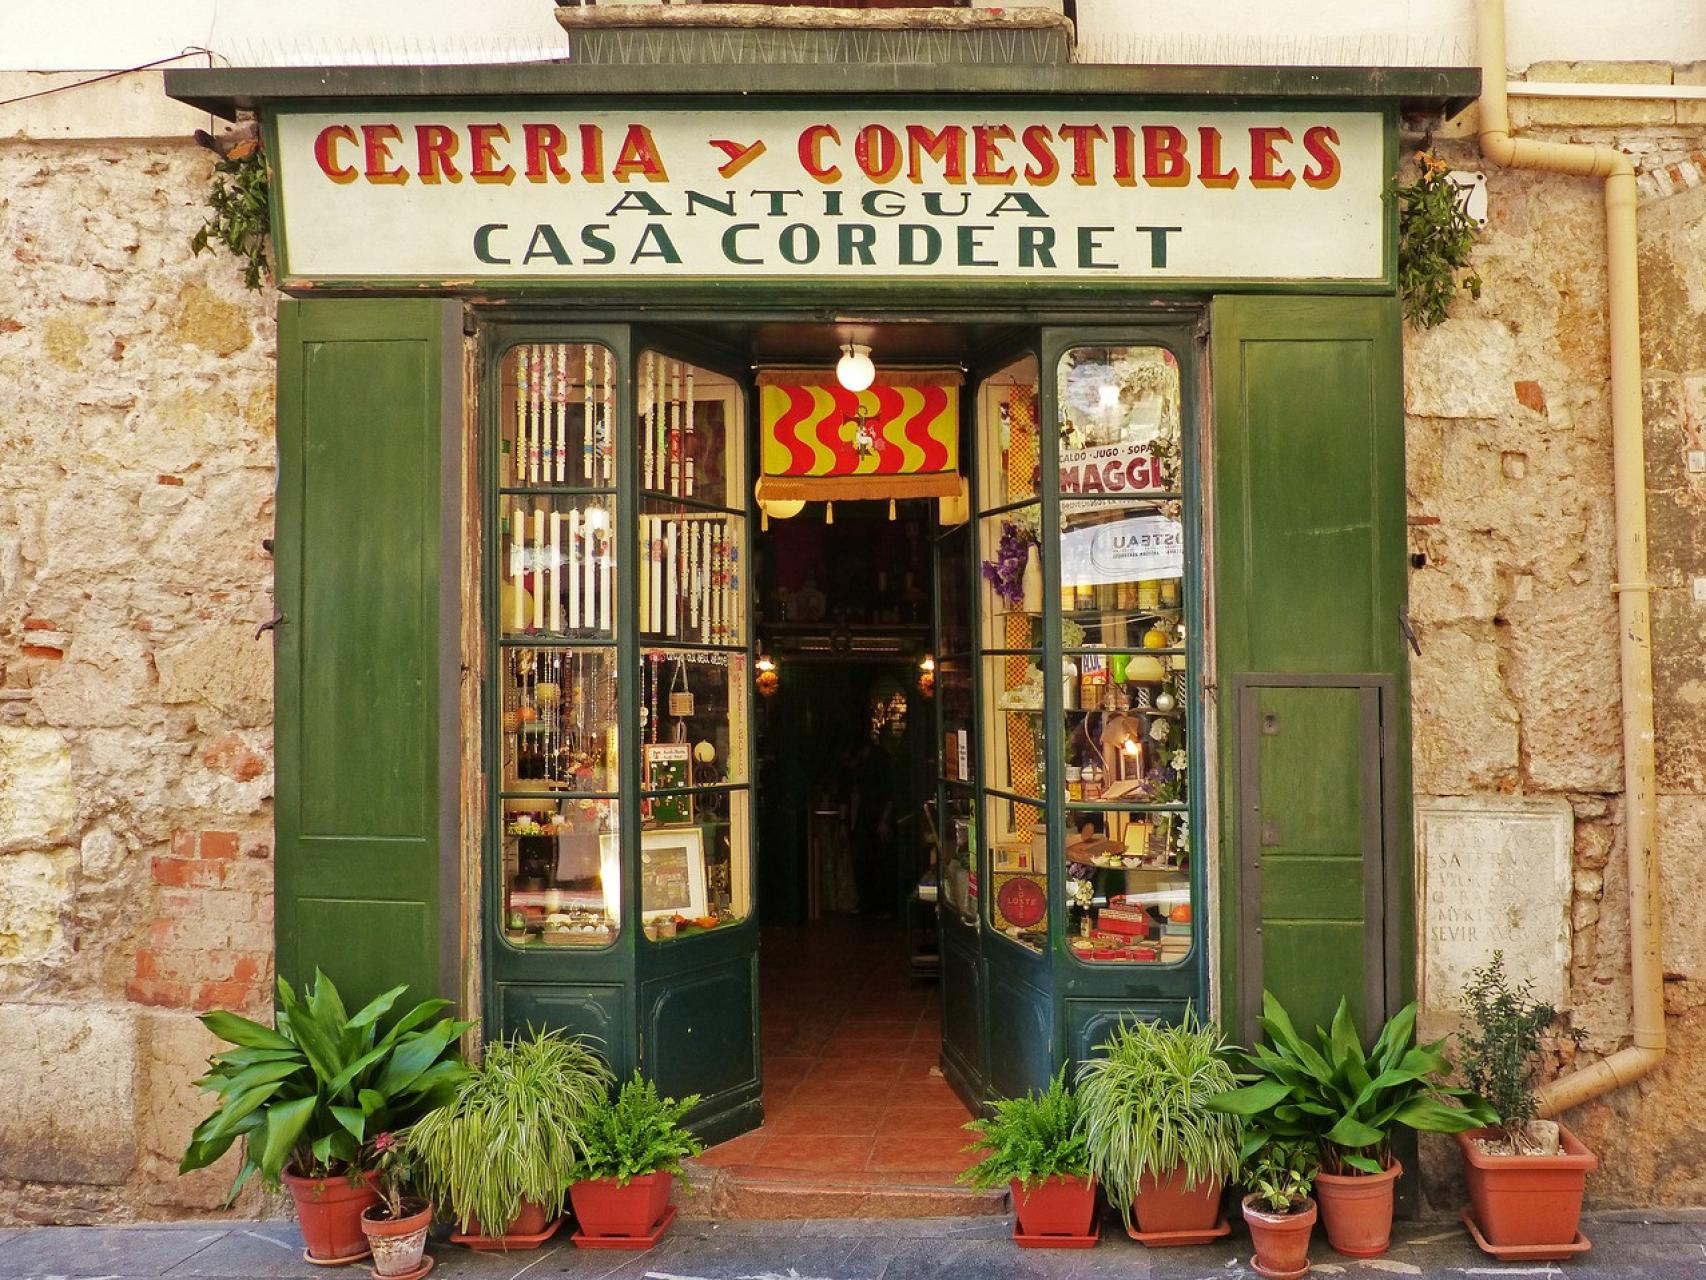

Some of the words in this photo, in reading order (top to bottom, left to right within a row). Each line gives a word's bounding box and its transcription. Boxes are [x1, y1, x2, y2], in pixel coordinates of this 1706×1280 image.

[314, 123, 670, 186] CERERIA
[797, 122, 1341, 190] COMESTIBLES
[606, 190, 1050, 217] ANTIGUA
[473, 223, 683, 265] CASA
[721, 223, 1182, 270] CORDERET
[1093, 448, 1119, 459] JUGO
[1059, 457, 1162, 494] MAGGI
